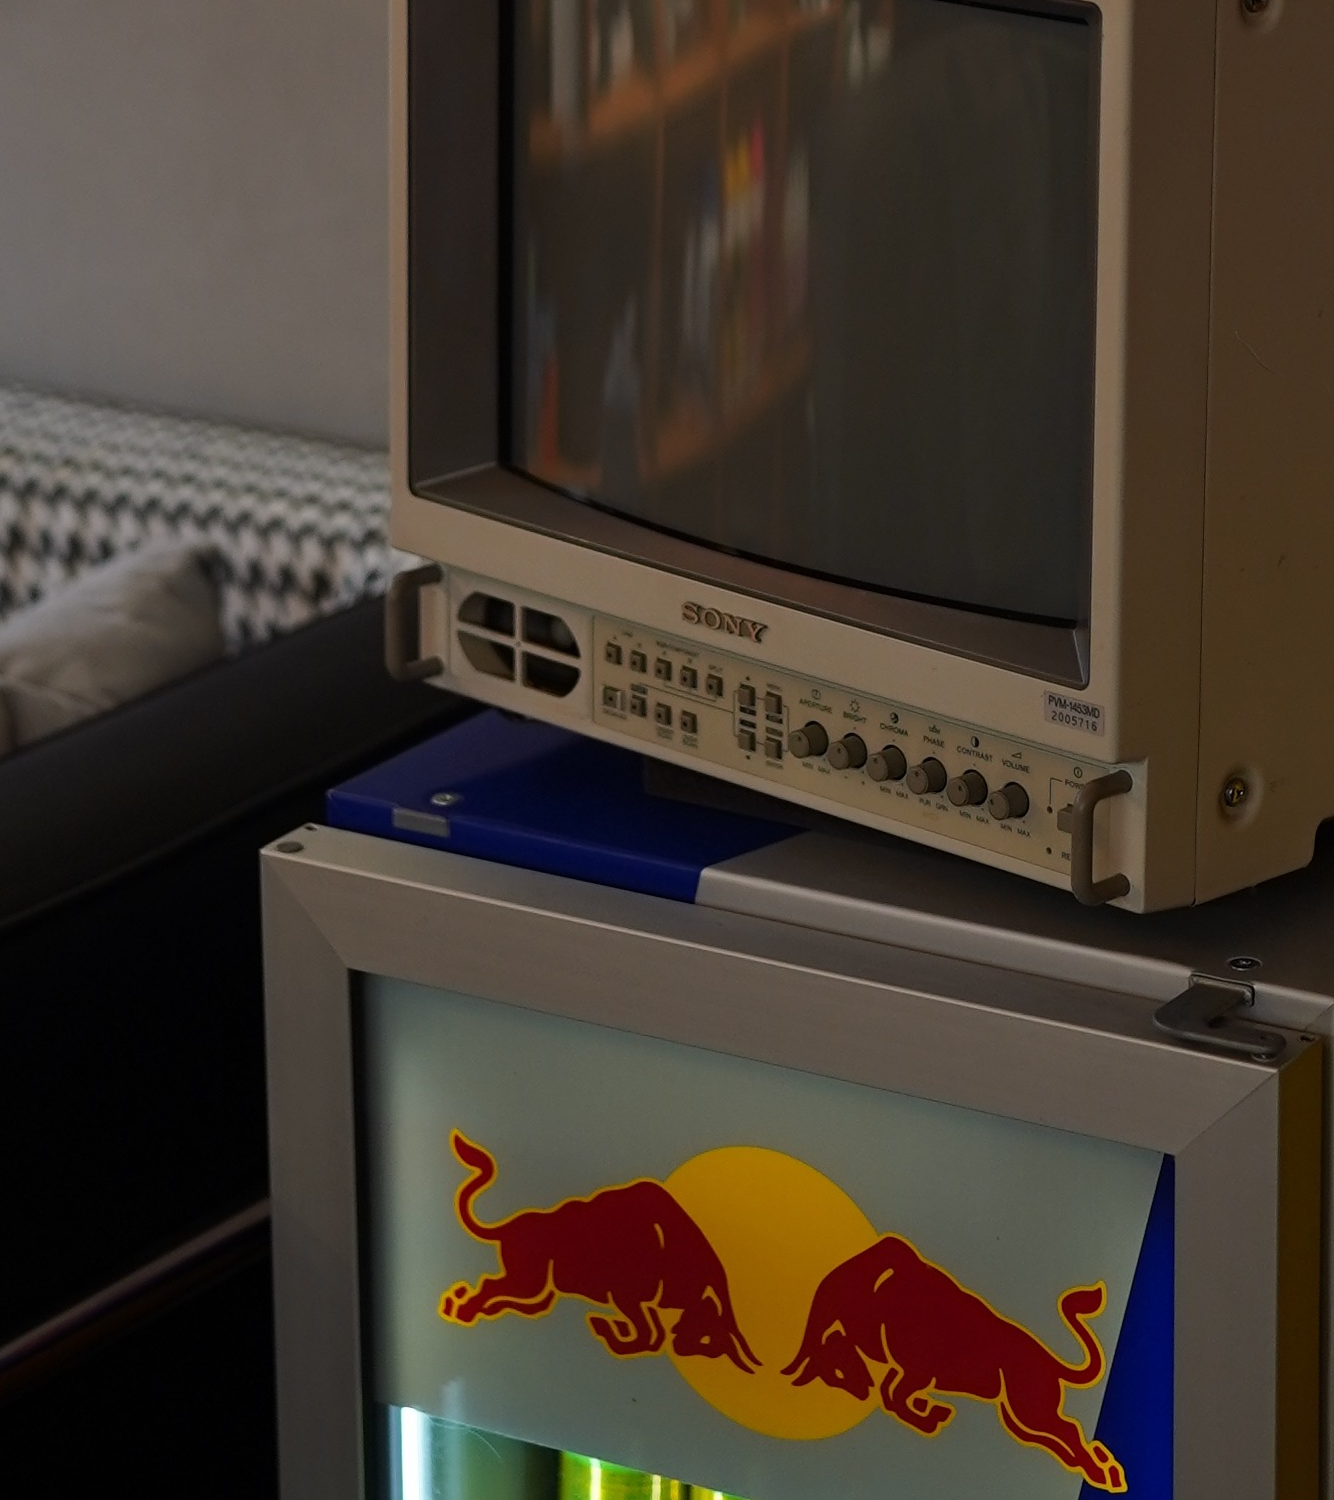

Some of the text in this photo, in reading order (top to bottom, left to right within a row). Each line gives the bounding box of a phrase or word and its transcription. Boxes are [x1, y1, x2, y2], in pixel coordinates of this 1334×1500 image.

[682, 601, 768, 643] SONY
[1048, 694, 1100, 719] PVM-1453MD
[879, 722, 909, 737] CHROMA
[1051, 710, 1098, 732] 2005716
[923, 735, 945, 748] PHASE
[956, 745, 993, 762] CONTRAST
[1001, 758, 1030, 774] VOLUME
